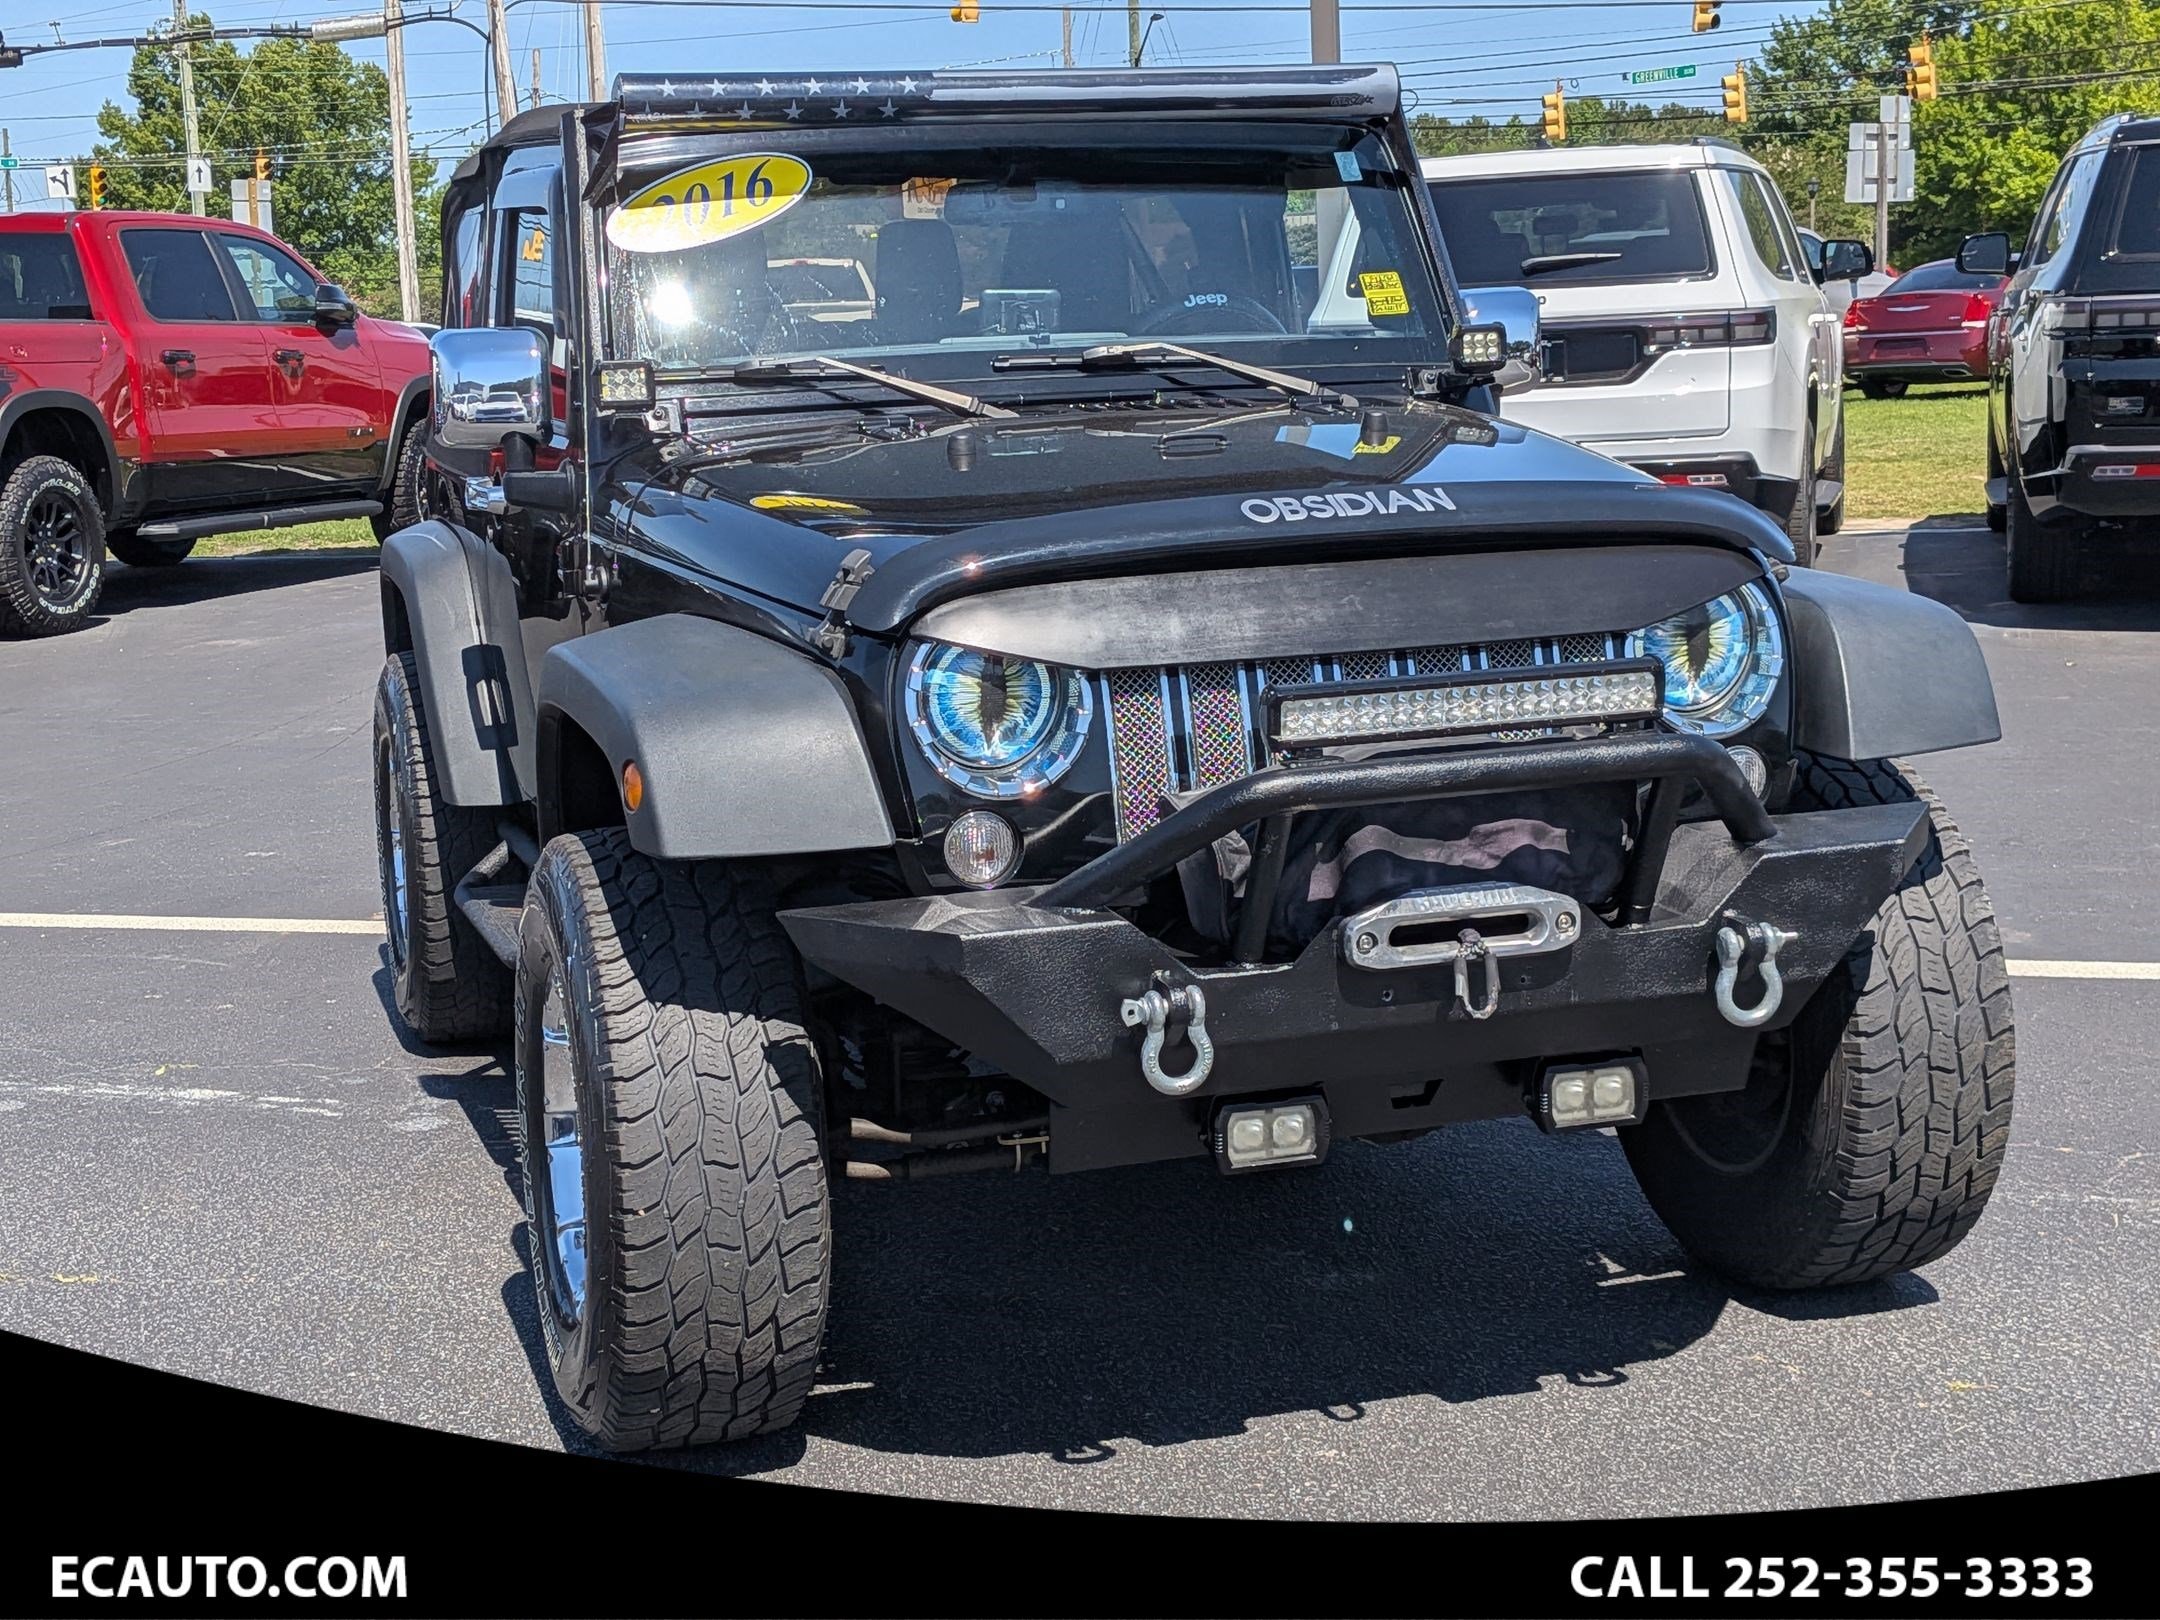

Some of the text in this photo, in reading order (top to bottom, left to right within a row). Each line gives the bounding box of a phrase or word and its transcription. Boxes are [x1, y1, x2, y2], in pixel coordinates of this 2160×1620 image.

[1635, 67, 1679, 83] GREENVILLE
[652, 158, 773, 230] 2016
[1184, 293, 1228, 308] Jeep
[1240, 487, 1457, 524] OBSIDIAN
[515, 1062, 566, 1373] DISCOVERER
